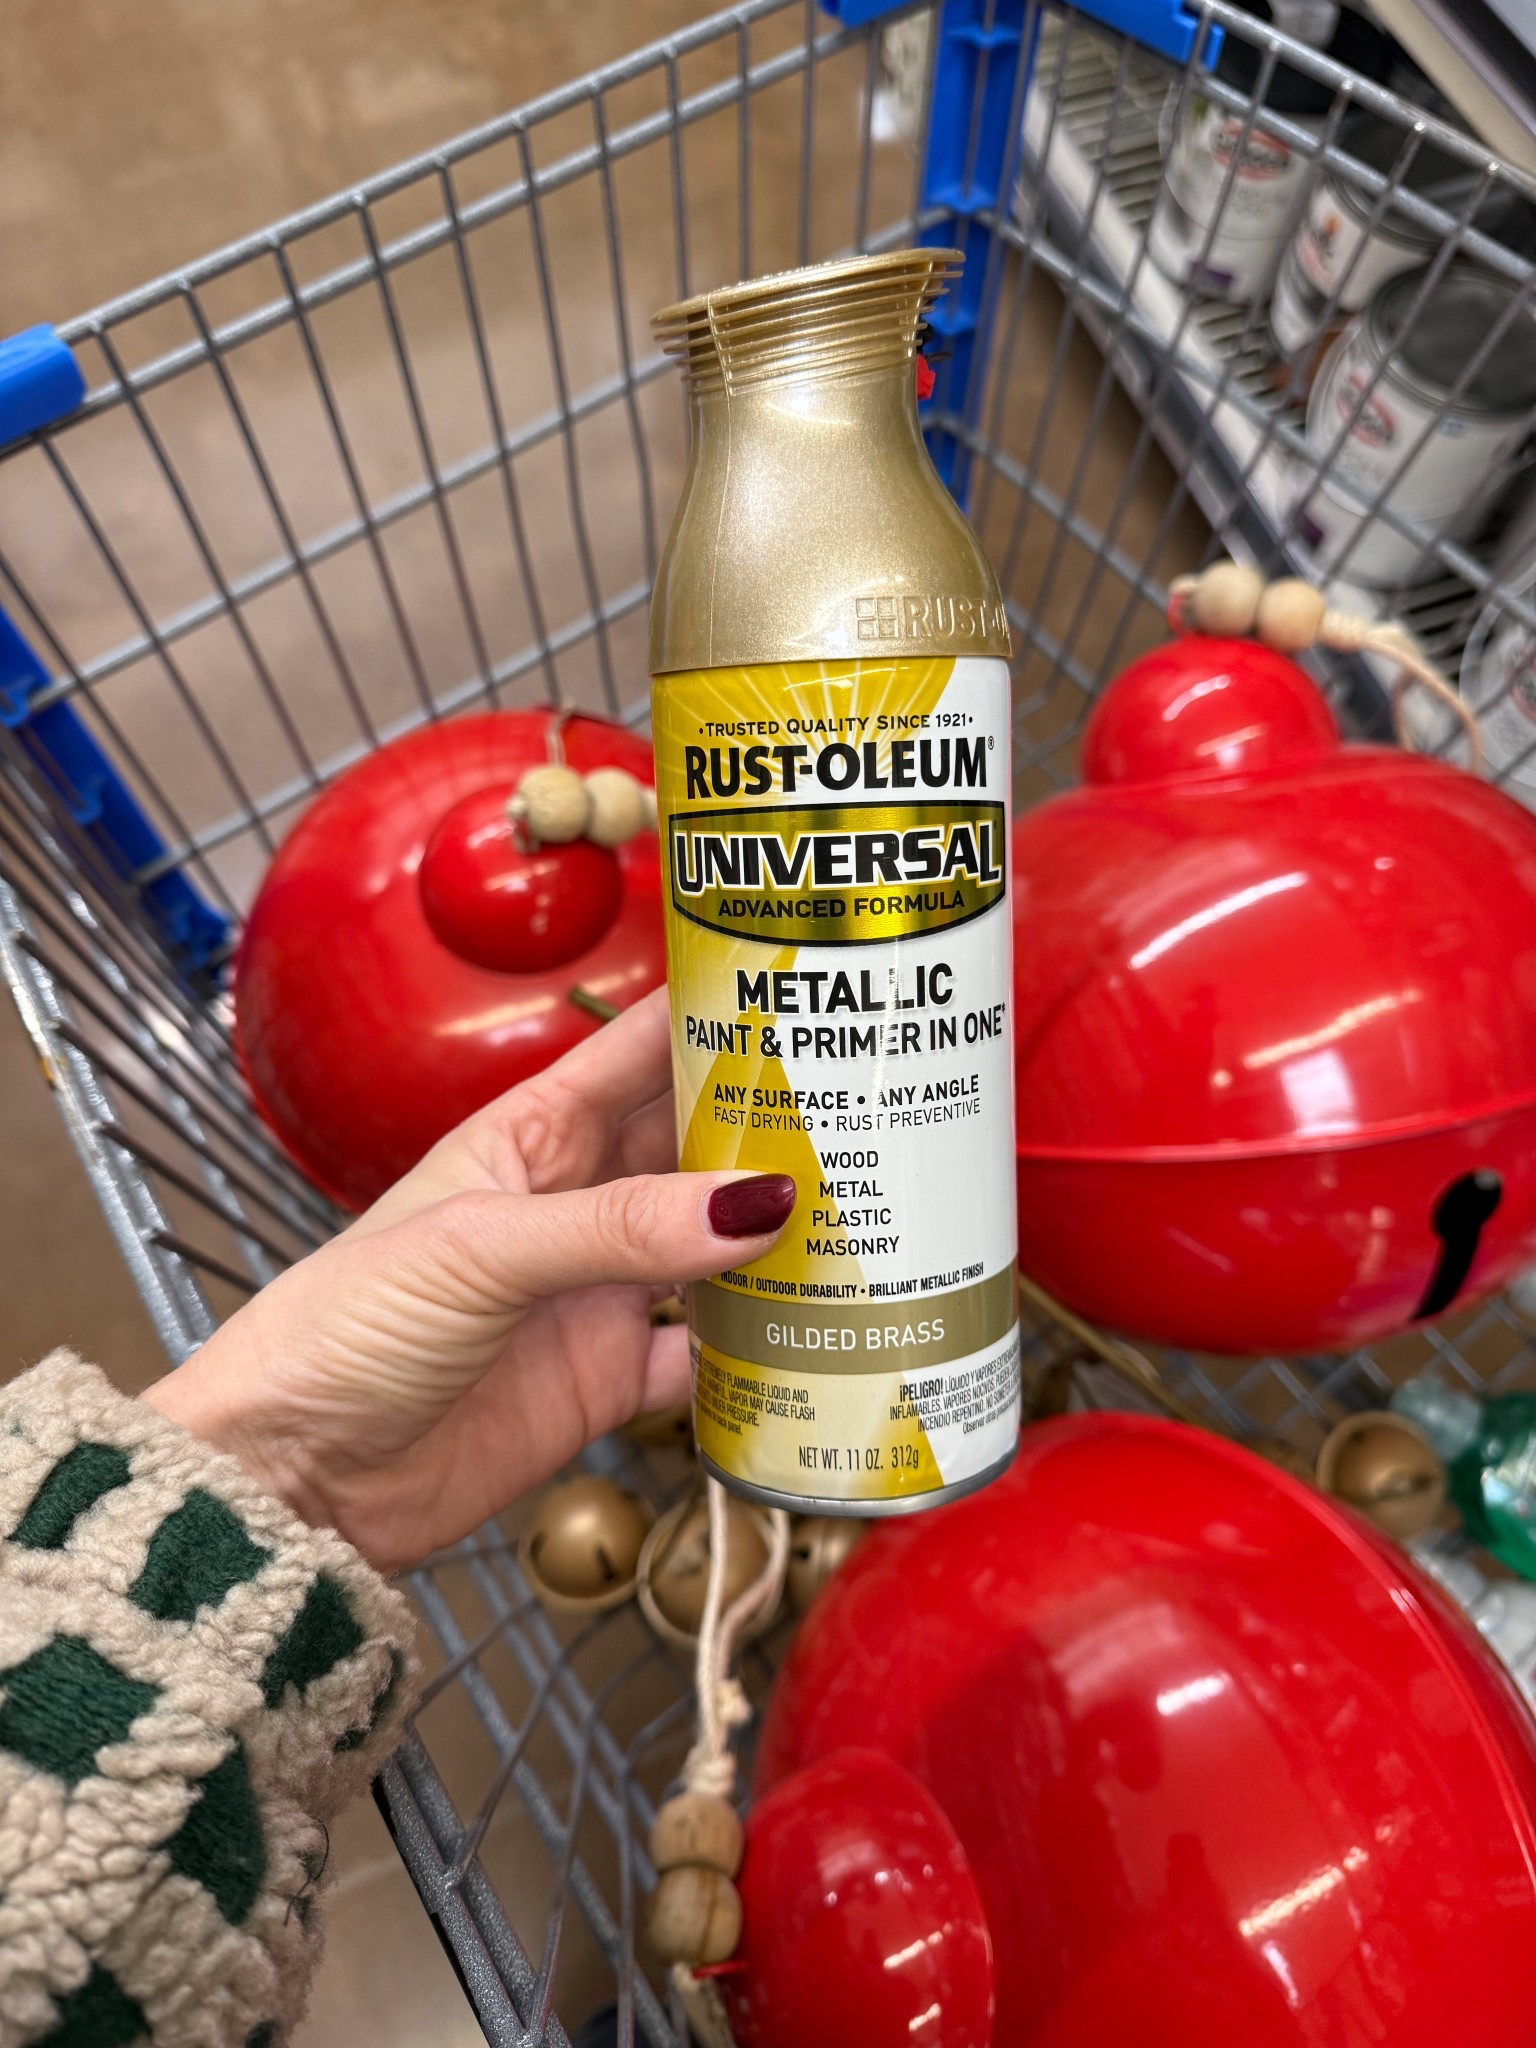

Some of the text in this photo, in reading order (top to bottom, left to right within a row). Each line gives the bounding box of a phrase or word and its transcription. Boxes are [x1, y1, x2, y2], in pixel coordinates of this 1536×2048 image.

[705, 713, 967, 737] TRUSTED QUALITY SINCE 1921
[673, 820, 1002, 897] UNIVERSAL
[717, 890, 965, 919] ADVANCED FORMULA
[736, 962, 953, 1014] METALLIC
[685, 1014, 752, 1057] PAINT
[760, 1025, 783, 1058] &
[791, 1023, 922, 1059] PRIMER
[929, 1016, 957, 1051] IN
[714, 1073, 980, 1111] ANY SURFACE ANY ANGLE
[713, 1097, 981, 1132] FAST DRYING RUST PREVENTIVE
[820, 1150, 880, 1170] WOOD
[819, 1179, 884, 1199] METAL
[811, 1207, 892, 1228] PLASTIC
[806, 1235, 900, 1257] MASONRY
[720, 1270, 749, 1289] INDOOR
[756, 1277, 798, 1296] OUTDOOR
[800, 1283, 857, 1299] DURABILITY
[868, 1279, 918, 1298] BRILLIANT
[920, 1269, 960, 1291] METALLIC
[961, 1260, 984, 1282] FINISH
[765, 1318, 945, 1351] GILDED BRASS
[727, 1372, 766, 1397] FLAMMABLE
[767, 1384, 791, 1401] LIQUID
[792, 1388, 809, 1404] AND
[943, 1388, 972, 1410] VAPORES
[728, 1388, 748, 1407] VAPOR
[749, 1396, 764, 1412] MAY
[765, 1401, 789, 1418] CAUSE
[791, 1404, 816, 1421] FLASH
[917, 1411, 951, 1432] INCENDIO
[798, 1445, 919, 1471] NET WT. 11 OZ. 312g
